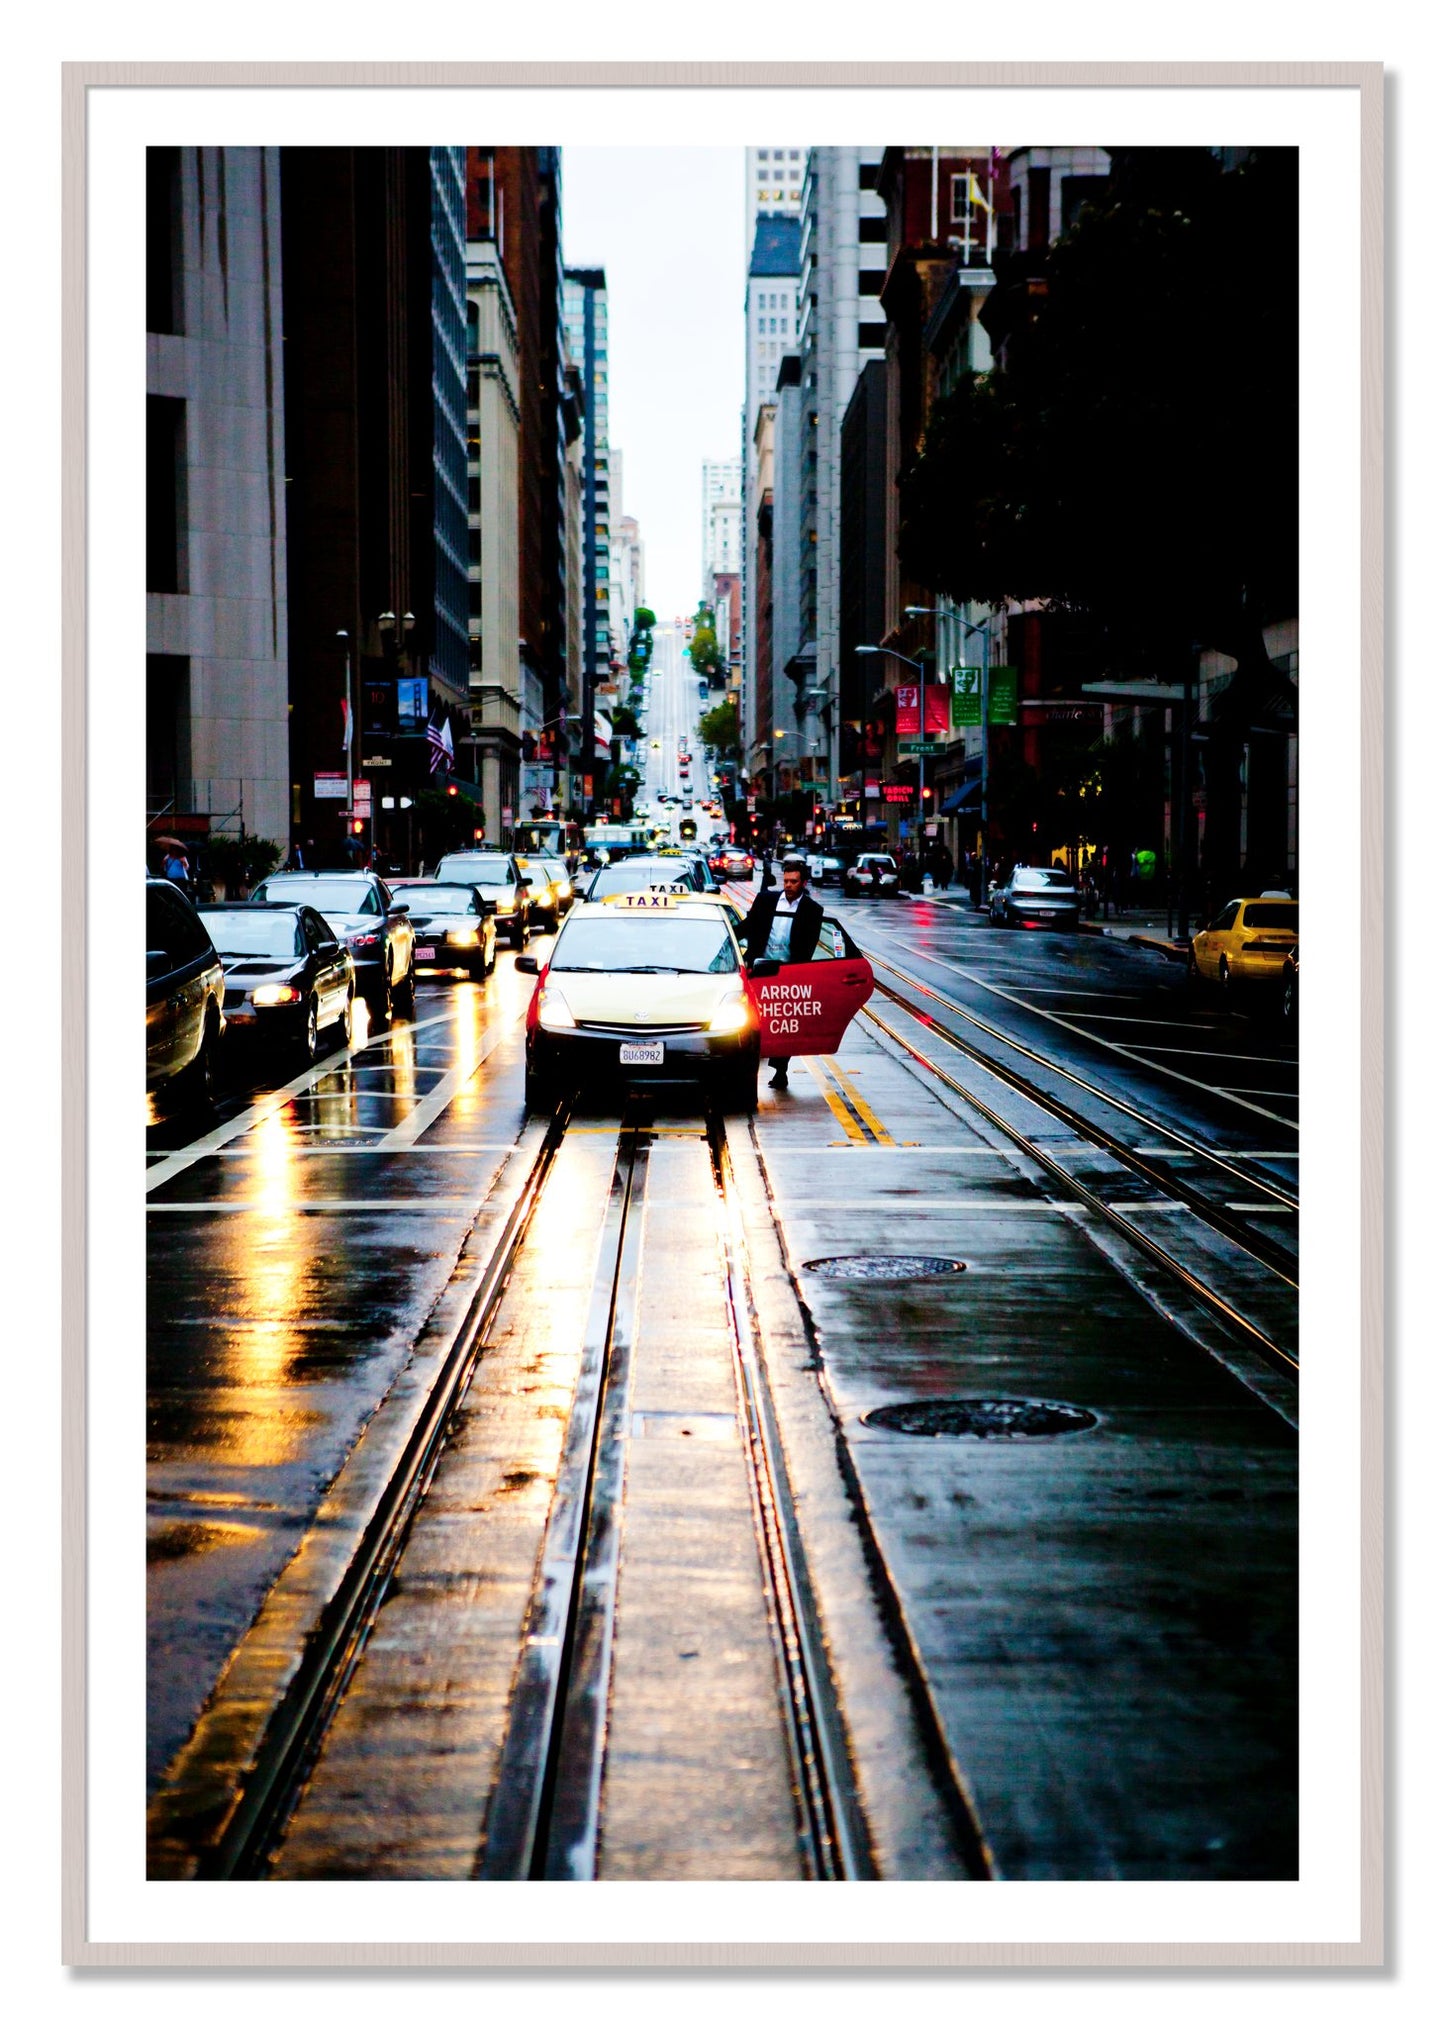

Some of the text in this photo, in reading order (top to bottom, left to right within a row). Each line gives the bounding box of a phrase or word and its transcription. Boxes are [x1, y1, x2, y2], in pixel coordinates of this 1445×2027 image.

[910, 744, 935, 752] Front
[882, 785, 914, 795] TADICH
[886, 794, 910, 803] GRILL
[650, 885, 684, 893] TAXI
[626, 896, 668, 906] TAXI
[760, 984, 812, 1000] ARROW
[769, 1019, 799, 1034] CAB
[623, 1050, 661, 1061] 8U68982
